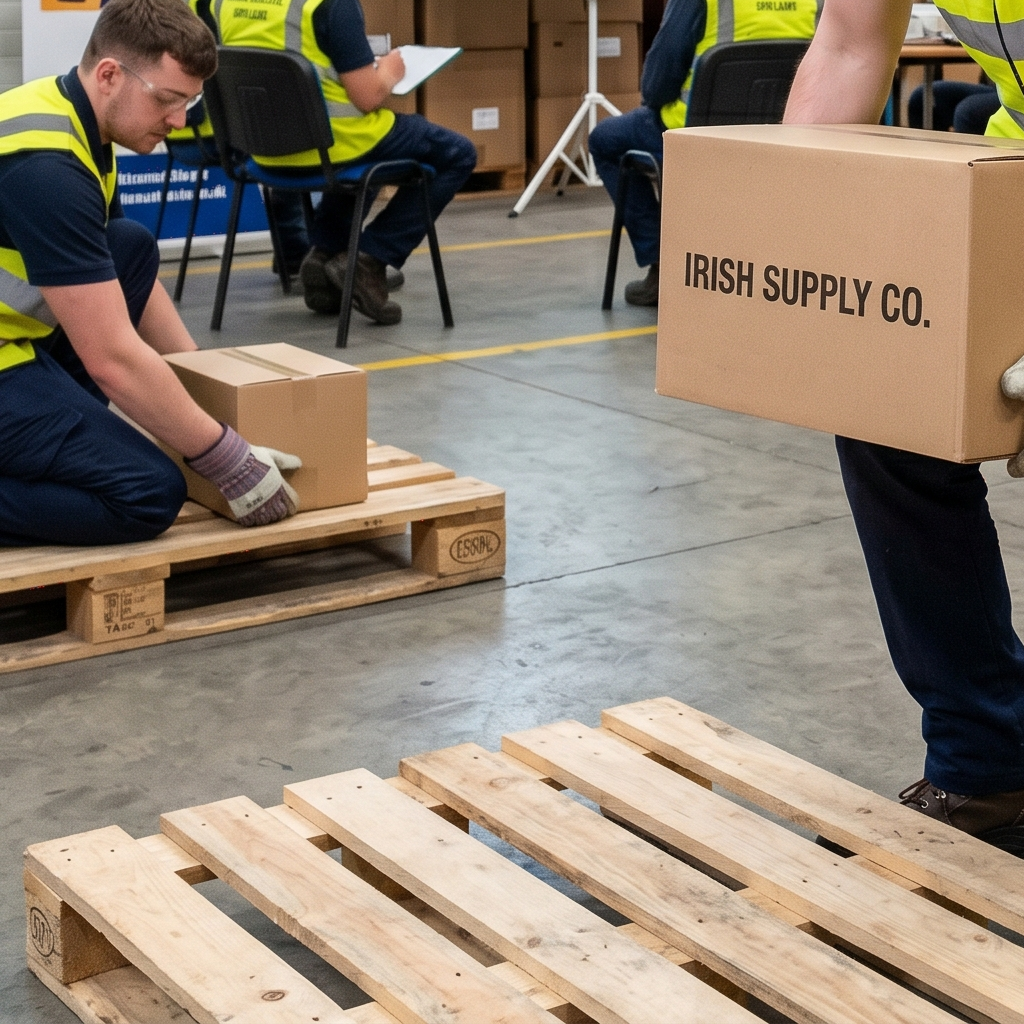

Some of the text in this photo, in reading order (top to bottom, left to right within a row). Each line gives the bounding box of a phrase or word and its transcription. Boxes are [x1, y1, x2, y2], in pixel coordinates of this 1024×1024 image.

[684, 252, 931, 328] IRISH SUPPLY CO.
